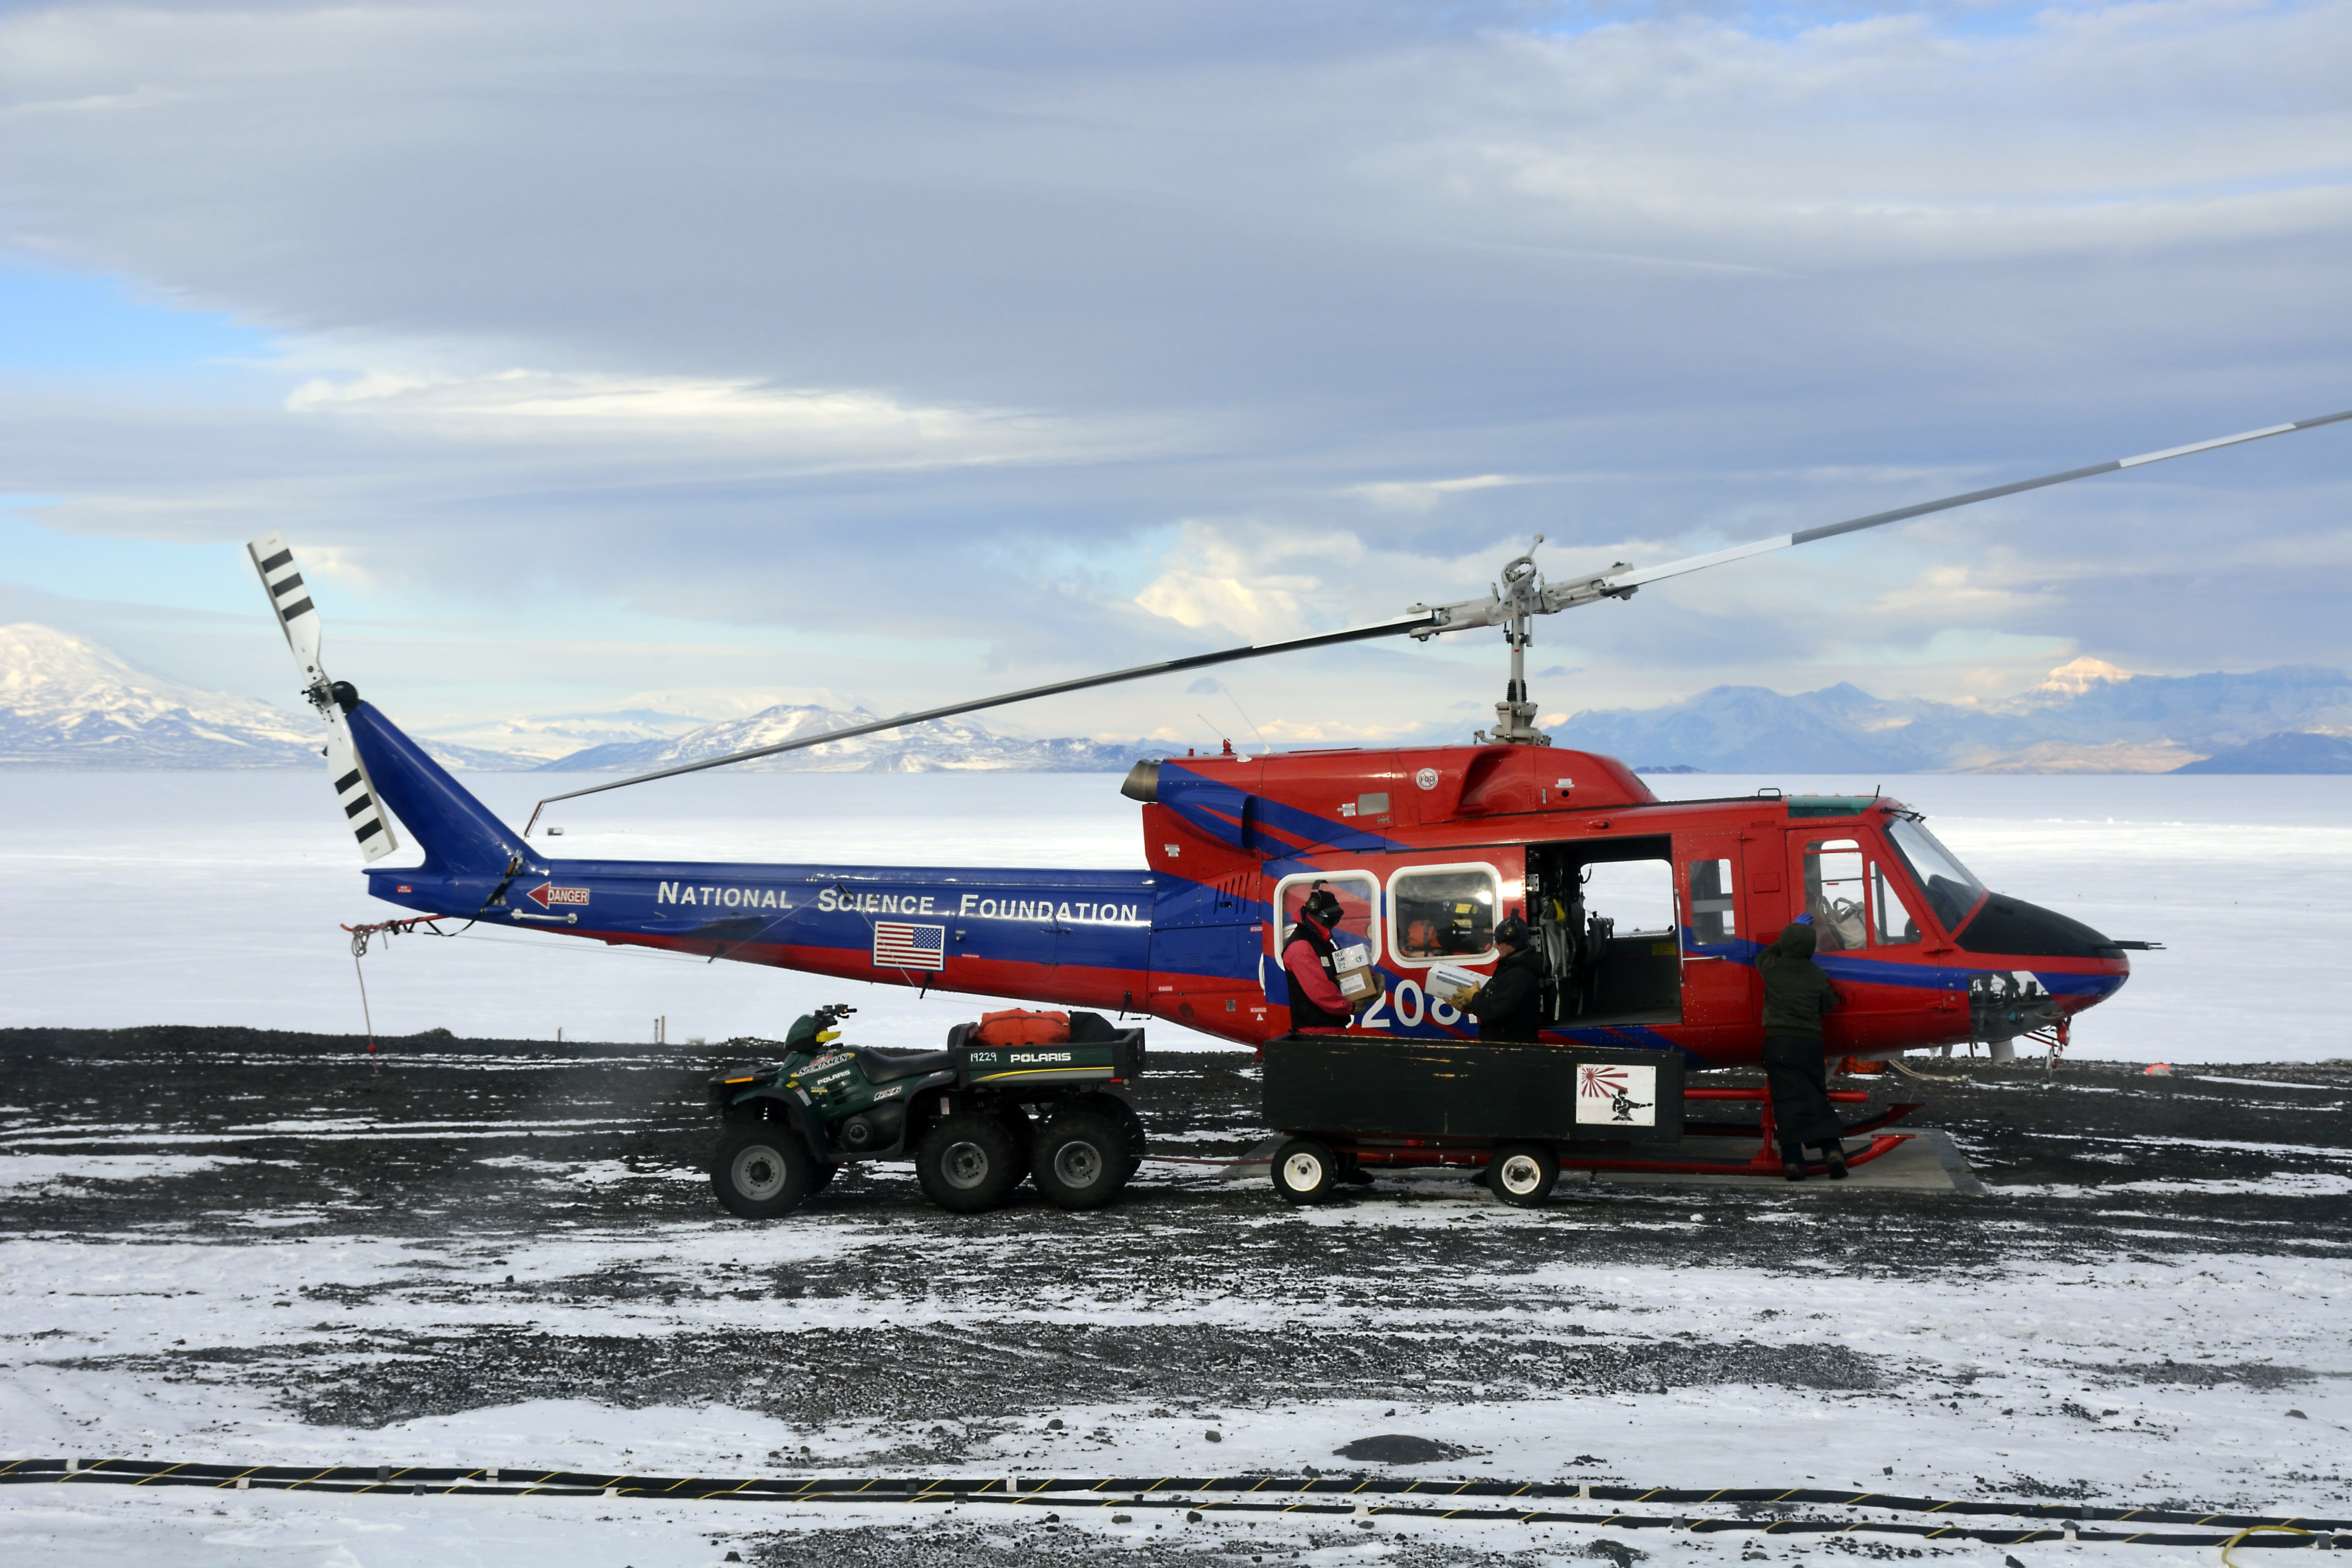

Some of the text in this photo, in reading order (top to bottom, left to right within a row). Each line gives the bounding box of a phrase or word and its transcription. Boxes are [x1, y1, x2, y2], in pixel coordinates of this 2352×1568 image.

[548, 889, 588, 902] DANGER
[971, 1052, 996, 1062] 19229
[1011, 1053, 1071, 1063] POLARIS
[798, 1053, 849, 1076] SPORTSMAN
[817, 1070, 850, 1085] POLARIS
